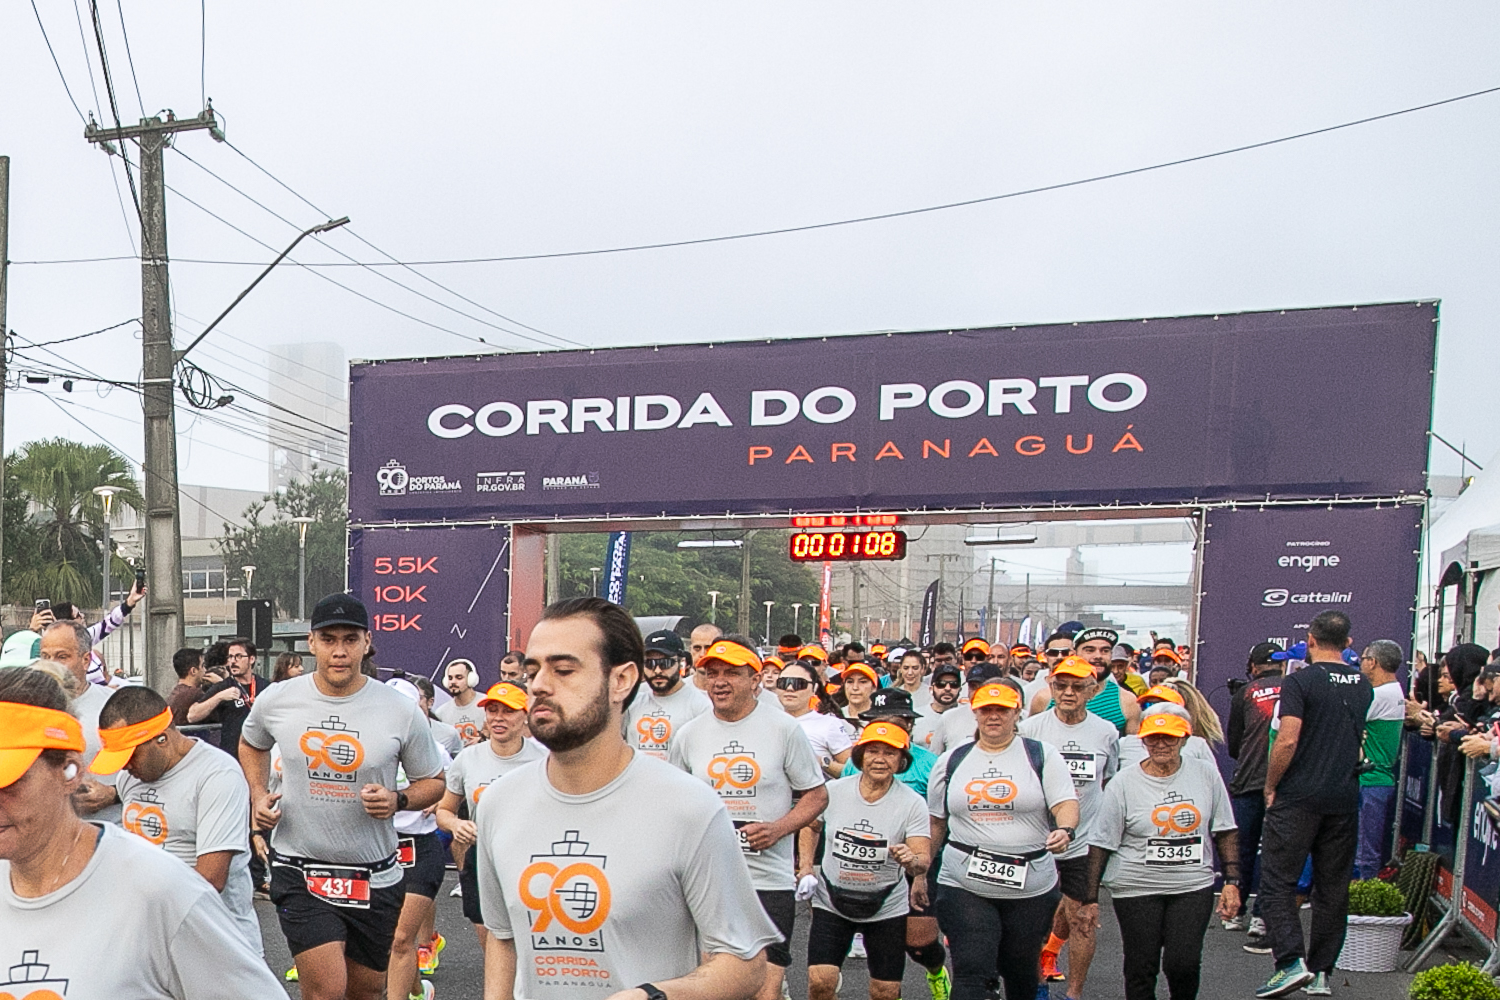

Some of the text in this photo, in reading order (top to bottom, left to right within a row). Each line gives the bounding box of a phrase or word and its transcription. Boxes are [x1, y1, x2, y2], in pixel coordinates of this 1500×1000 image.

[427, 372, 1148, 438] CORRIDA DO PORTO
[748, 424, 1144, 465] PARANAGUÁ
[409, 475, 445, 484] PORTOS
[409, 480, 462, 491] DO PARANÁ
[476, 476, 525, 484] INFRA
[476, 484, 525, 492] PR.GOV.BR
[543, 475, 588, 486] PARANÁ
[1278, 555, 1340, 573] engine
[374, 585, 428, 602] 10K
[1290, 591, 1353, 603] cattalini
[373, 614, 422, 631] 15K
[1329, 672, 1361, 685] STAFF
[636, 717, 672, 744] 90
[299, 730, 365, 773] 90
[312, 771, 353, 780] ANOS
[707, 756, 762, 789] 90
[964, 779, 1018, 804] 90
[1151, 803, 1201, 837] 90
[842, 842, 877, 859] 5793
[1157, 846, 1192, 859] 5345
[979, 861, 1016, 878] 5346
[321, 878, 353, 895] 431
[518, 862, 612, 935] 90
[538, 936, 599, 947] ANOS
[534, 956, 599, 967] CORRIDA
[536, 967, 611, 979] DO PORTO
